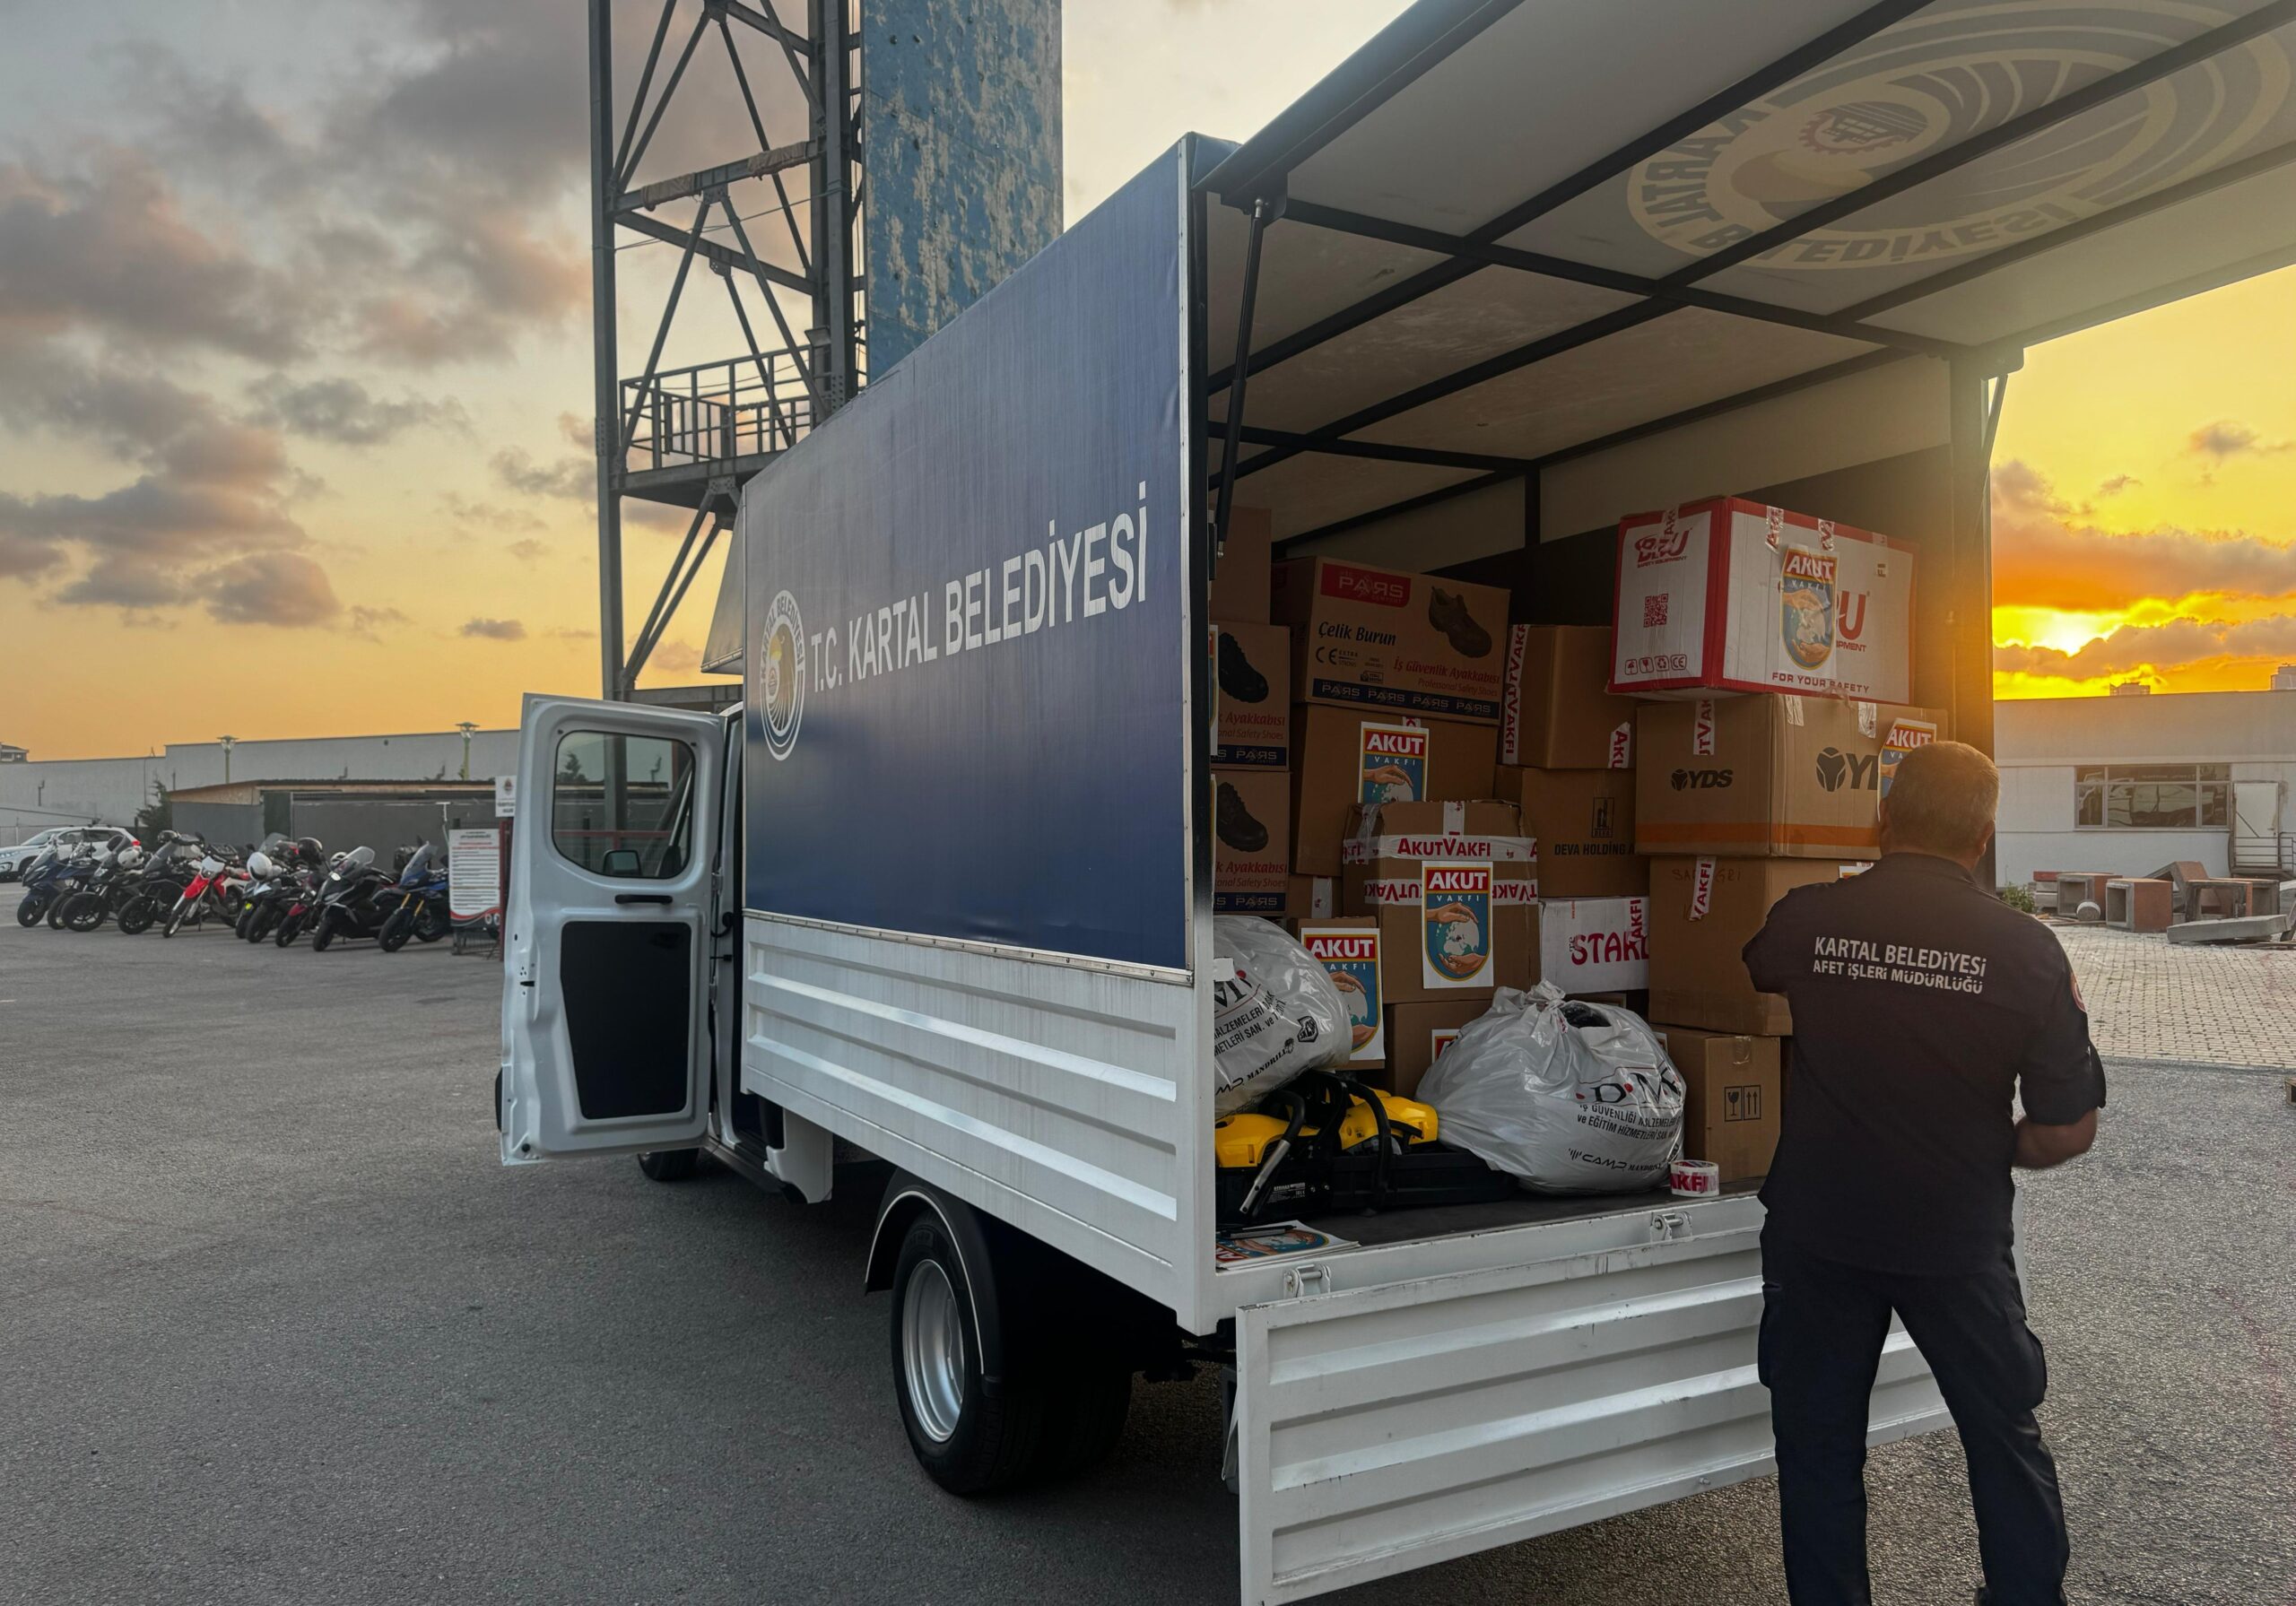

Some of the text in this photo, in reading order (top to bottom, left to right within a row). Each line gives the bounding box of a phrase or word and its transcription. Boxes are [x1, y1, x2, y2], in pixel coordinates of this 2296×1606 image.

[1787, 555, 1833, 579] AKUT
[811, 481, 1148, 693] T.C. KARTAL BELEDİYESİ
[1318, 621, 1352, 639] Çelik
[1356, 627, 1396, 647] Burun
[1394, 655, 1404, 672] İş
[1405, 660, 1448, 677] Güvenlik
[1449, 664, 1500, 684] Ayakkabısı
[1772, 672, 1870, 693] FOR YOUR SAFETY
[1227, 711, 1286, 727] Ayakkabısı
[1366, 735, 1424, 753] AKUT
[1886, 728, 1932, 749] AKUT
[1374, 756, 1416, 766] VAKFI
[1687, 769, 1734, 789] YDS
[1554, 843, 1579, 855] DEVA
[1583, 841, 1626, 855] HOLDİNG
[1227, 860, 1288, 874] Ayakkabısı
[1428, 872, 1487, 890] AKUT
[1310, 939, 1374, 958] AKUT
[1813, 936, 1987, 977] KARTAL BELEDİYESİ
[1813, 959, 1984, 995] AFET İŞLERİ MÜDÜRLÜĞÜ
[1588, 1116, 1617, 1133] EĞİTİM
